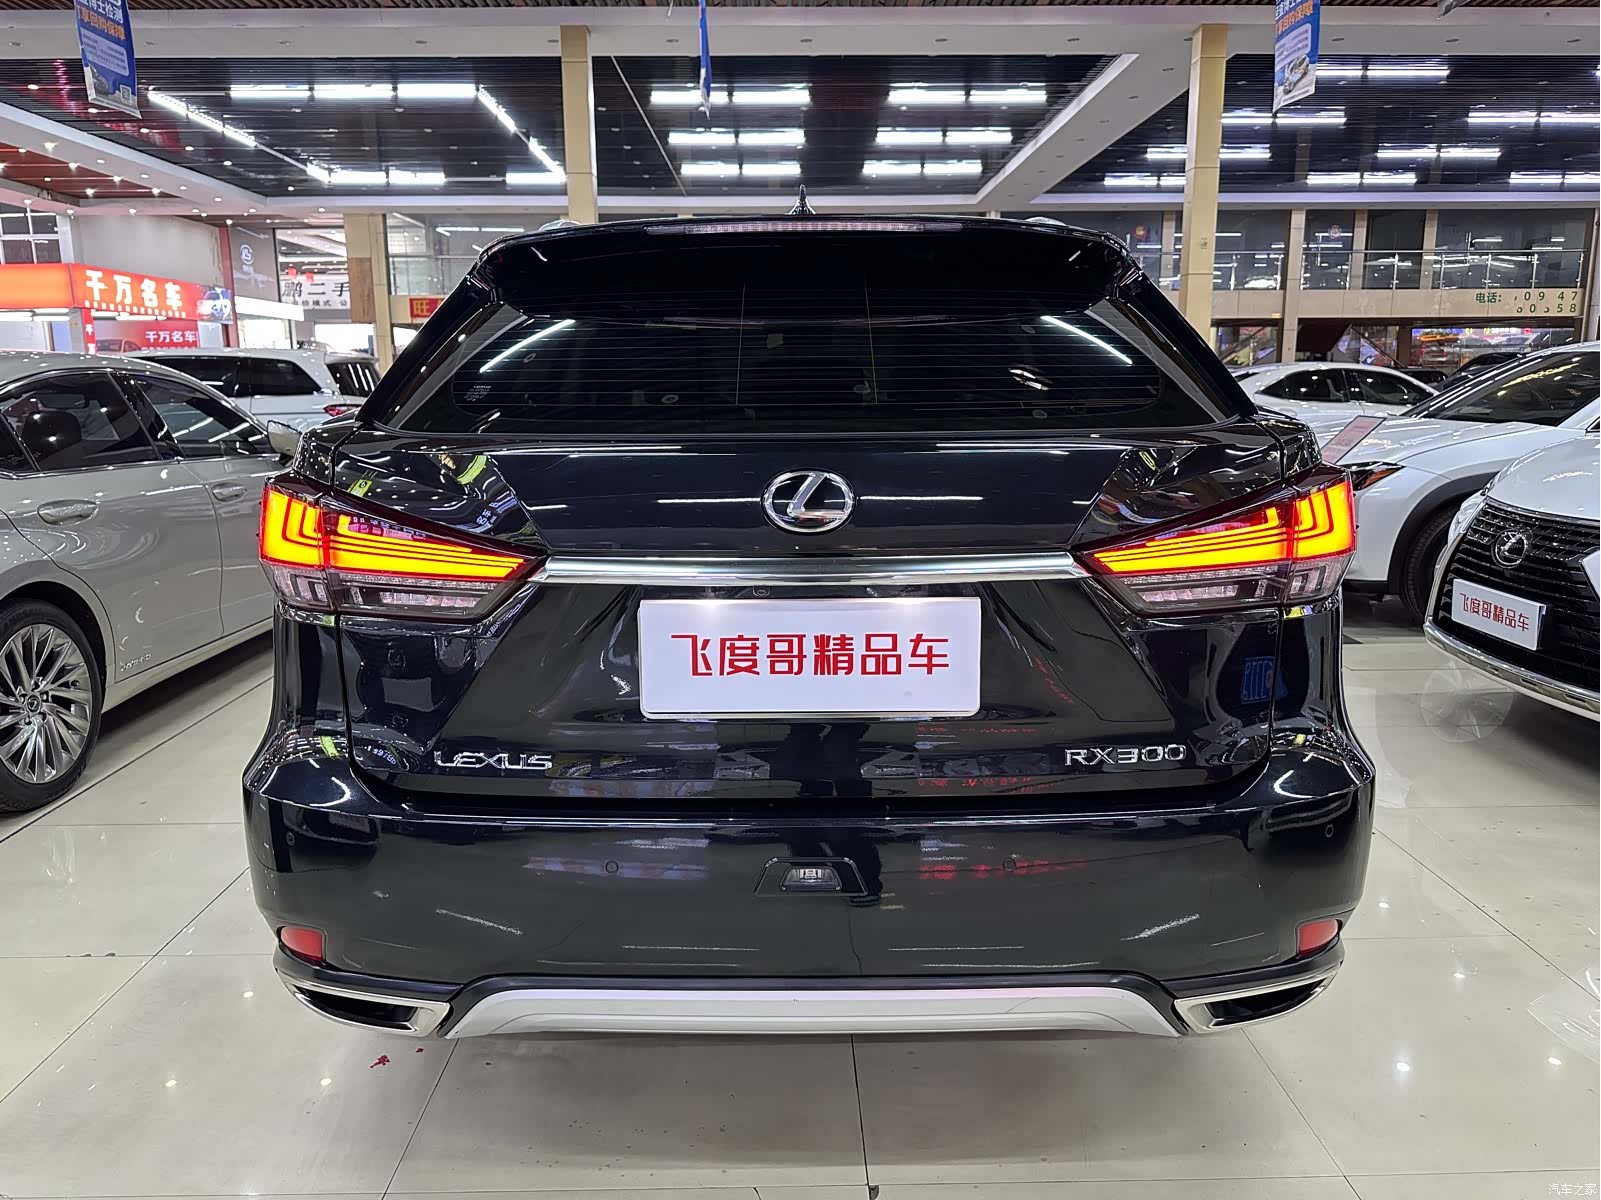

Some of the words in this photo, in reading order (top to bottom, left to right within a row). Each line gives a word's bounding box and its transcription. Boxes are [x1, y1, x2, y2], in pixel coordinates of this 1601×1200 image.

[85, 269, 183, 311] 千万名车
[145, 330, 197, 343] 千万名车
[1459, 592, 1530, 632] 飞度哥精品车
[670, 633, 950, 677] 飞度哥精品车
[433, 751, 552, 770] LEXUS
[1064, 744, 1187, 766] RX300
